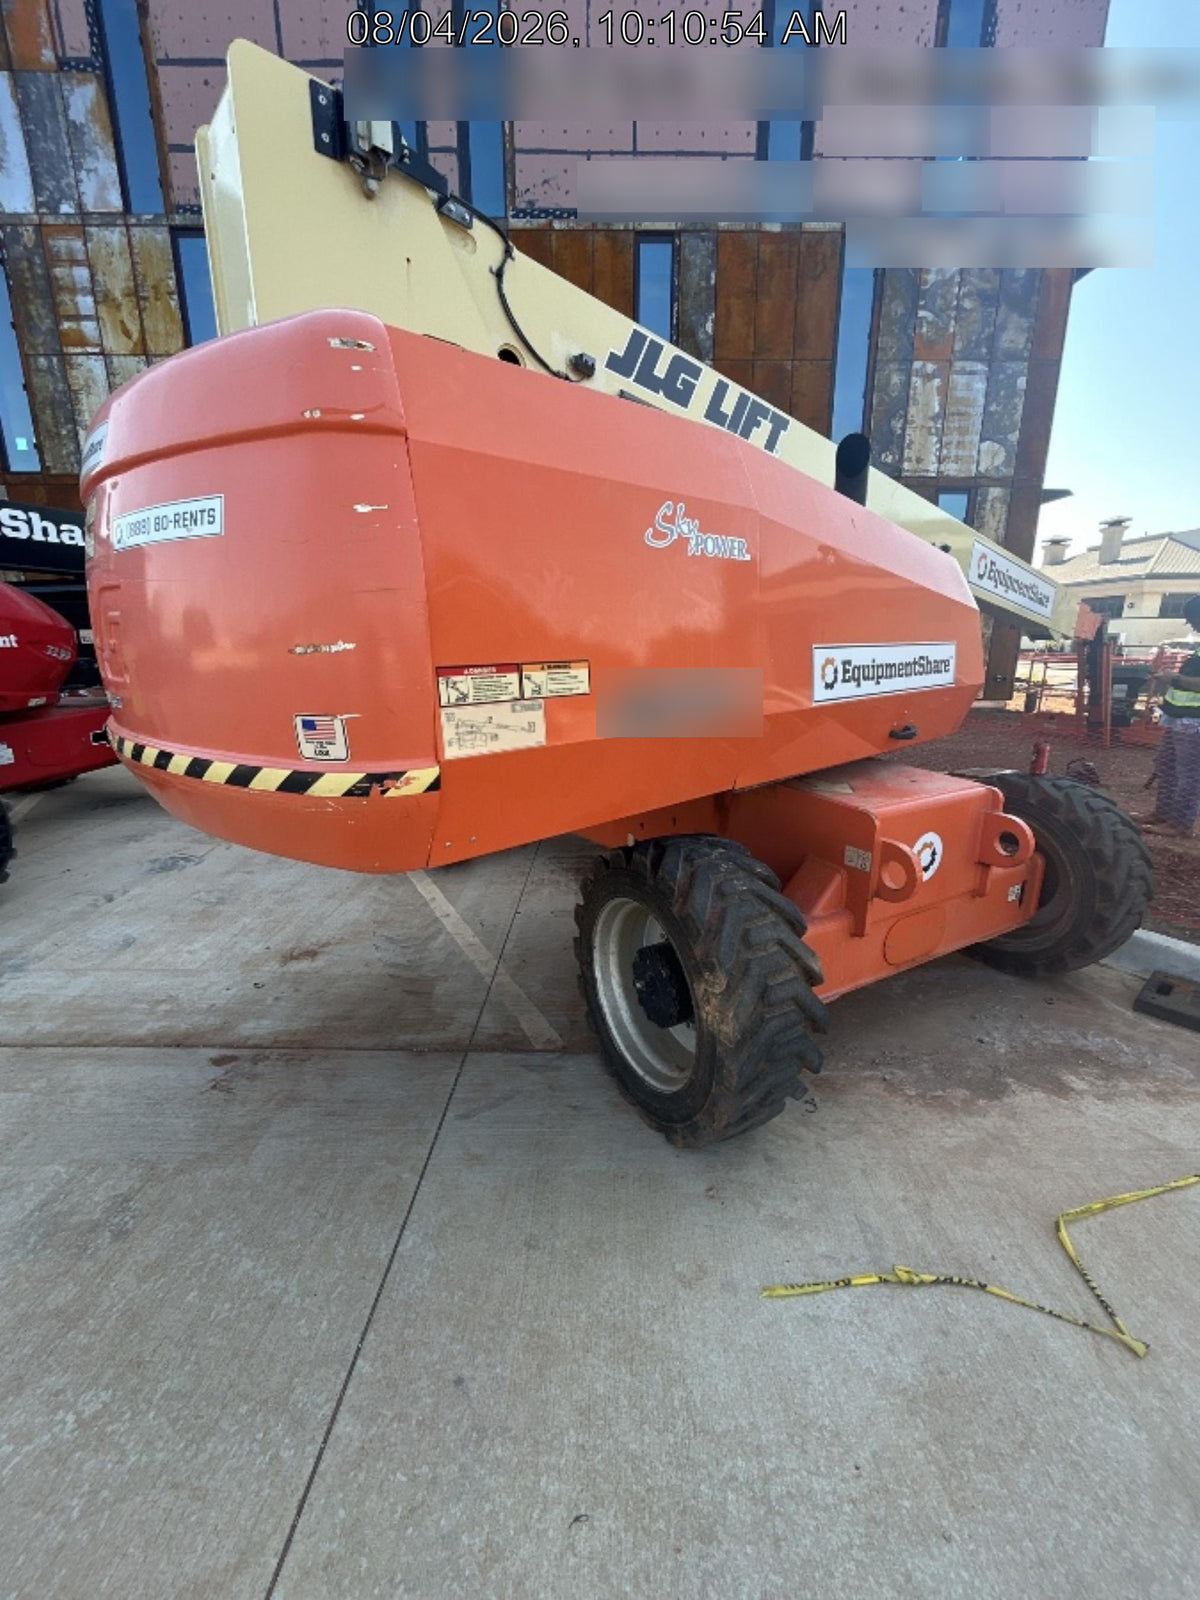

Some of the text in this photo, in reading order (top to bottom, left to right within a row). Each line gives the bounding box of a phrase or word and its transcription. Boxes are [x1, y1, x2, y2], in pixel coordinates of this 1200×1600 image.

[603, 327, 791, 455] JLG LIFT
[644, 500, 699, 557] Sky
[841, 655, 951, 688] EquipmentShare
